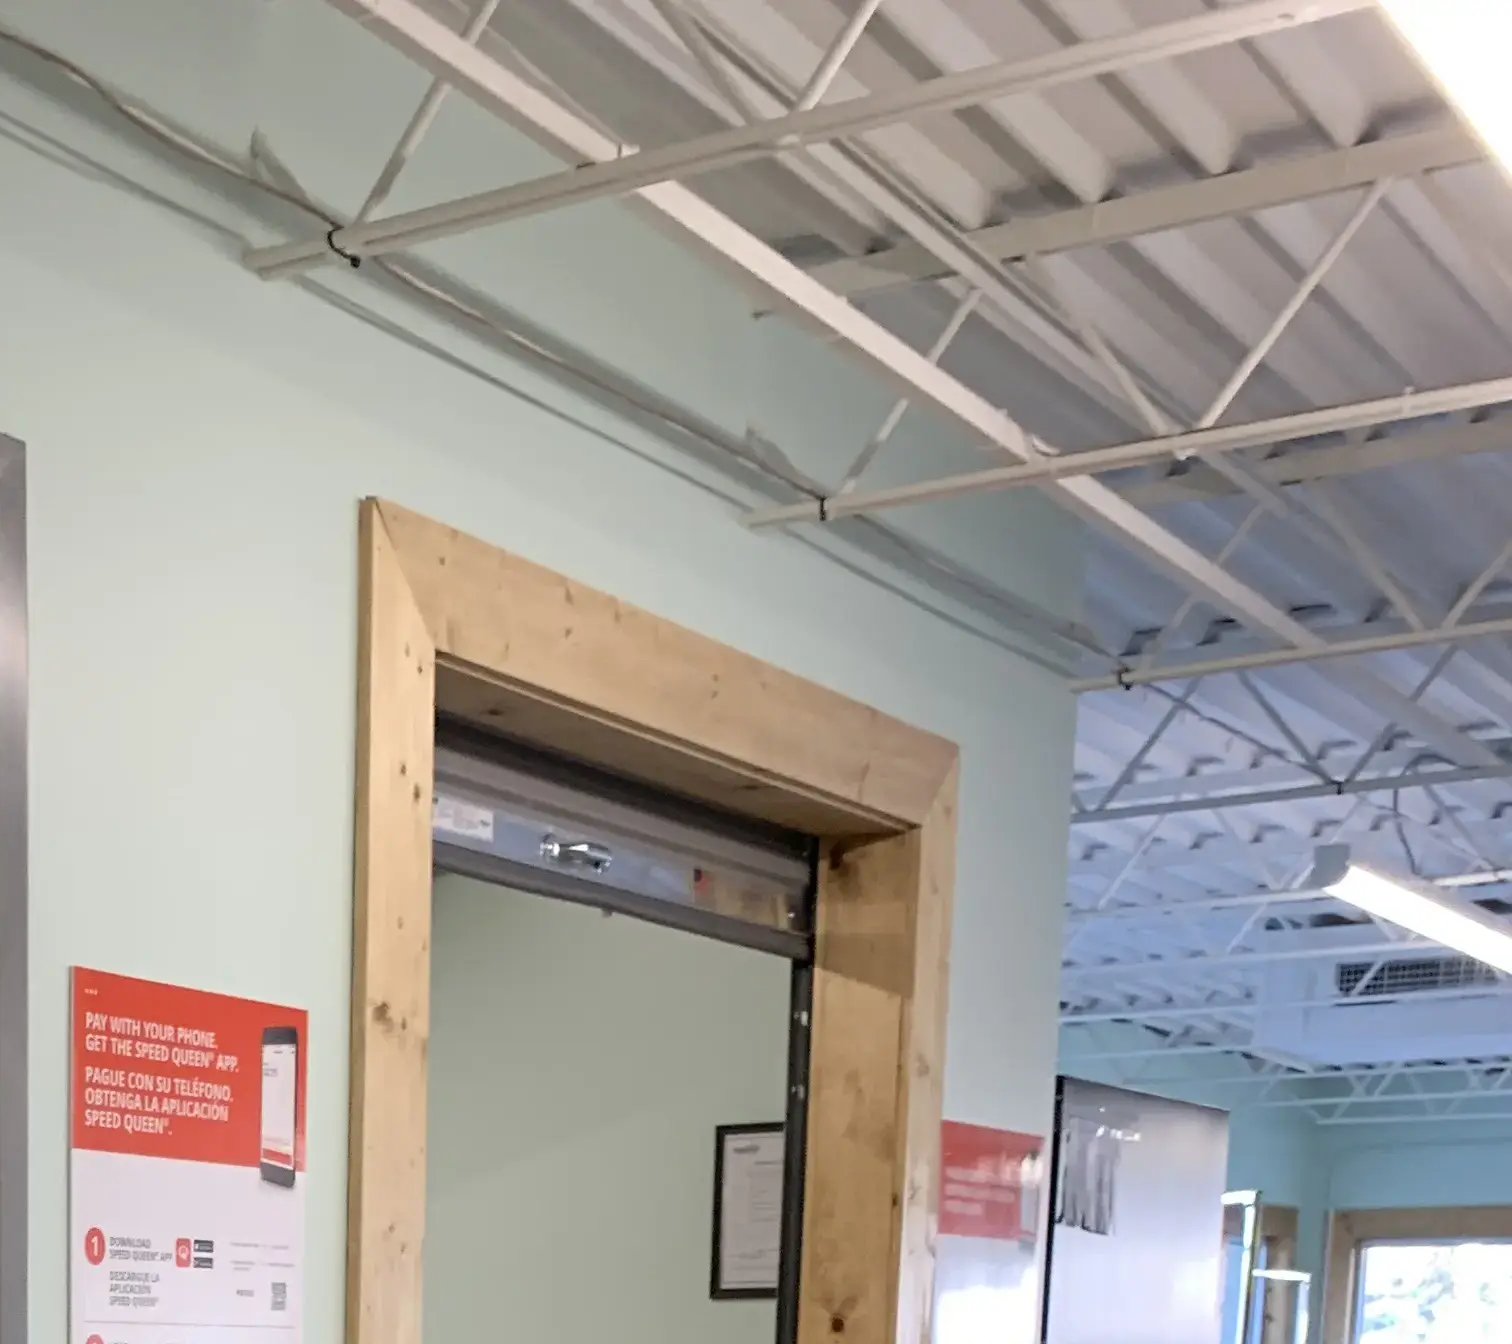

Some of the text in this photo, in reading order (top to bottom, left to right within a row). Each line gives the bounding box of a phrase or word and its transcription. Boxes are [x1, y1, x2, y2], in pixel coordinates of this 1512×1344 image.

[85, 1011, 218, 1049] PAY WITH YOUR PHONE.
[86, 1034, 107, 1052] GET
[110, 1038, 132, 1056] THE
[135, 1041, 169, 1061] SPEED
[215, 1054, 239, 1072] APP.
[85, 1066, 233, 1102] PAGUE CON SU TELÉFONO.
[85, 1088, 228, 1121] OBTENGA LA APLICACIÓN
[85, 1109, 121, 1129] SPEED
[91, 1236, 98, 1256] 1
